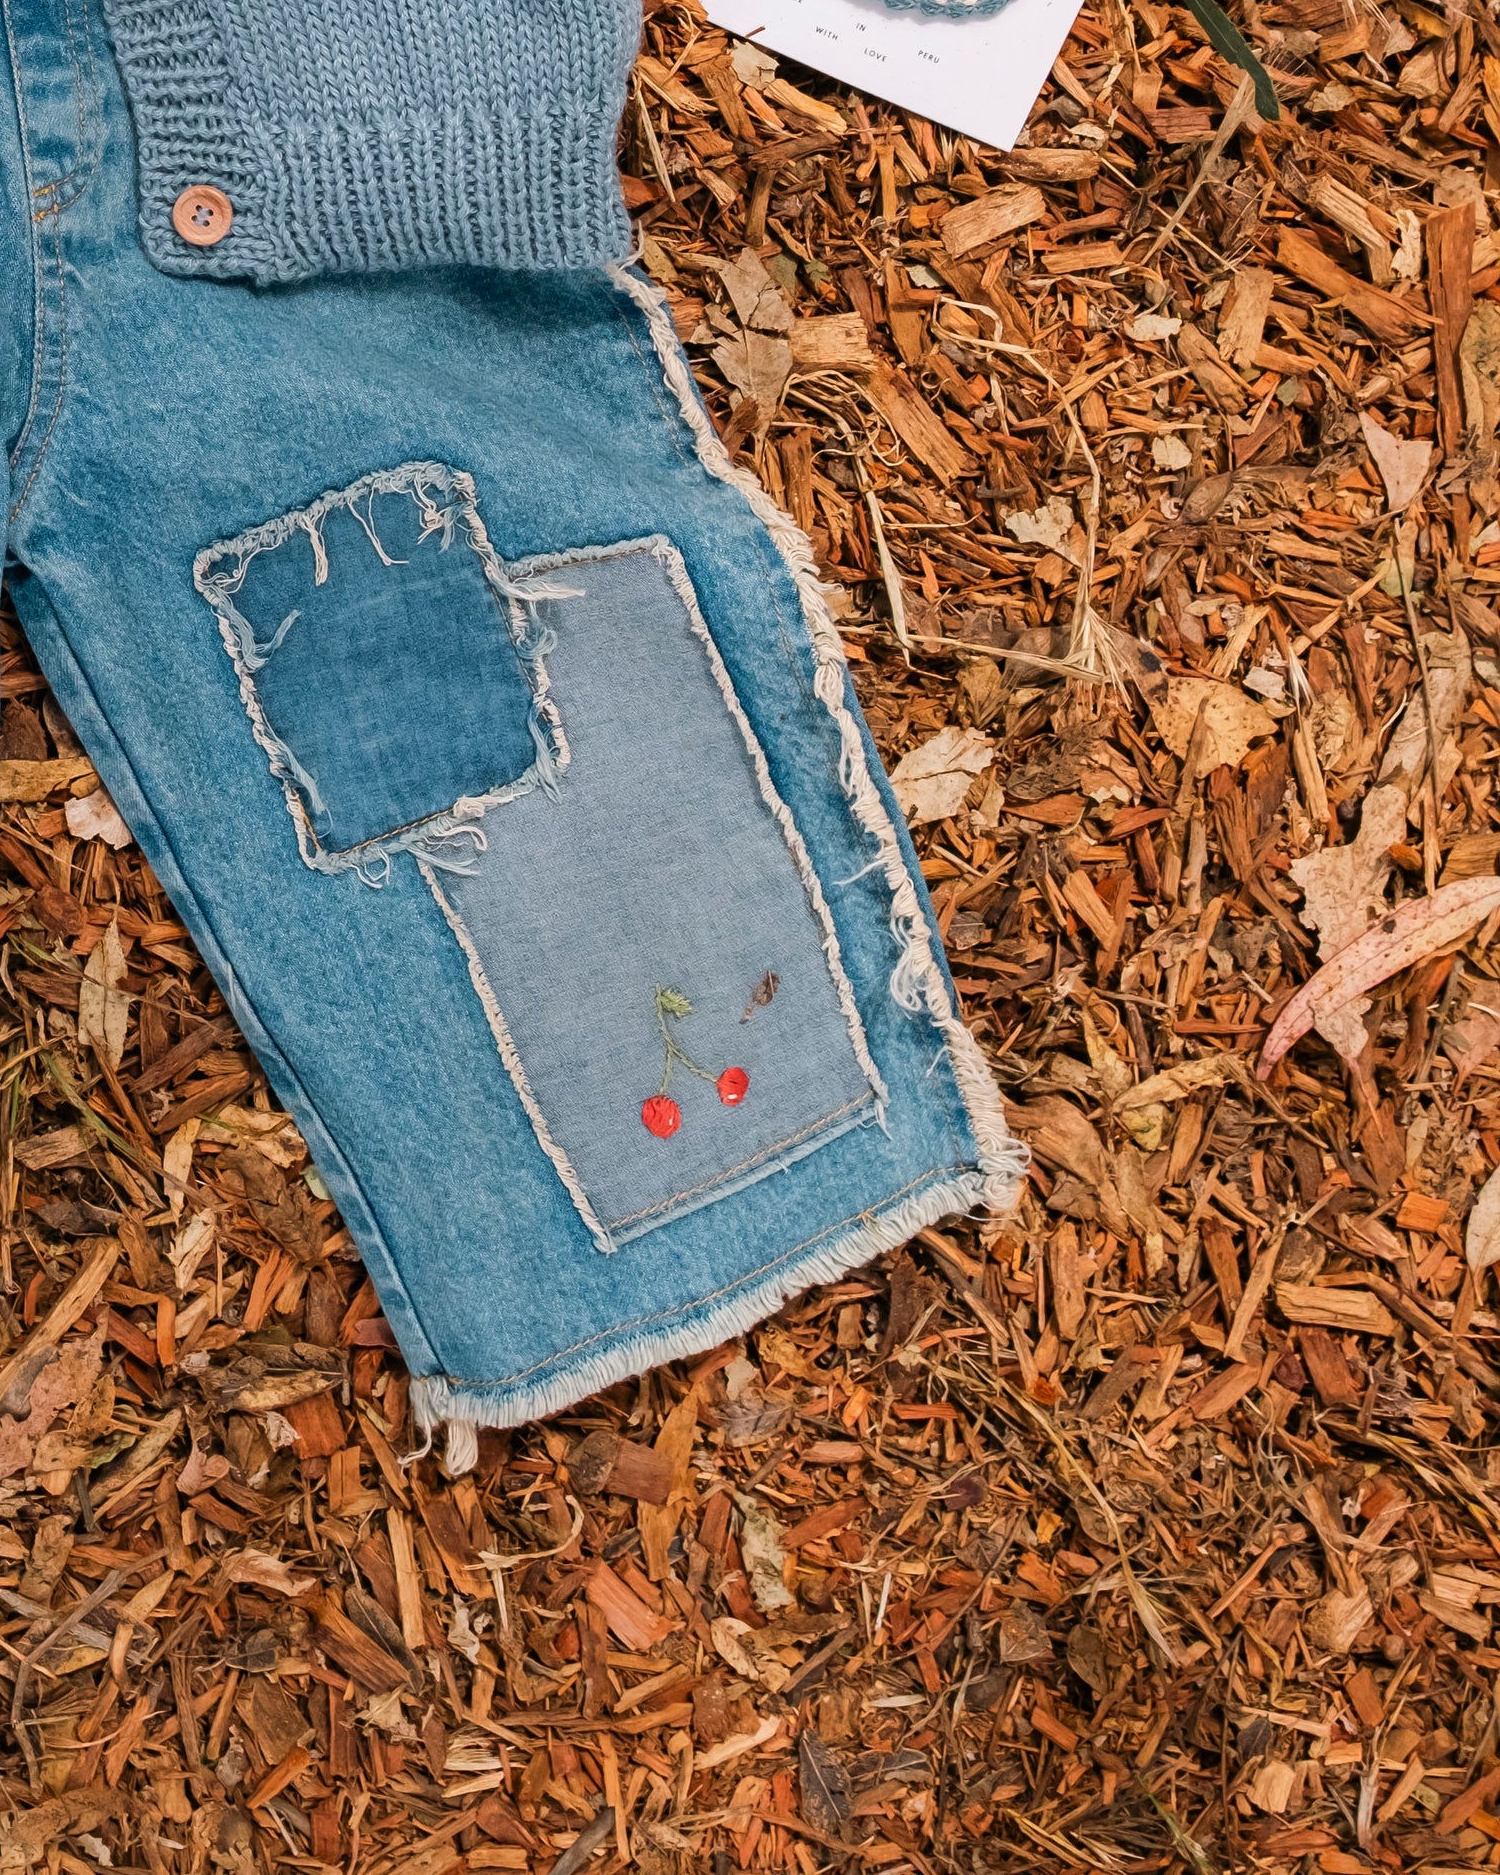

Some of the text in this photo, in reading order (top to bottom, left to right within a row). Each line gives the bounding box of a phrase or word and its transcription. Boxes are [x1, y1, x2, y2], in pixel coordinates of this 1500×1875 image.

[814, 26, 888, 63] WITH LOVE
[855, 22, 867, 33] IN
[917, 49, 941, 65] PERU
